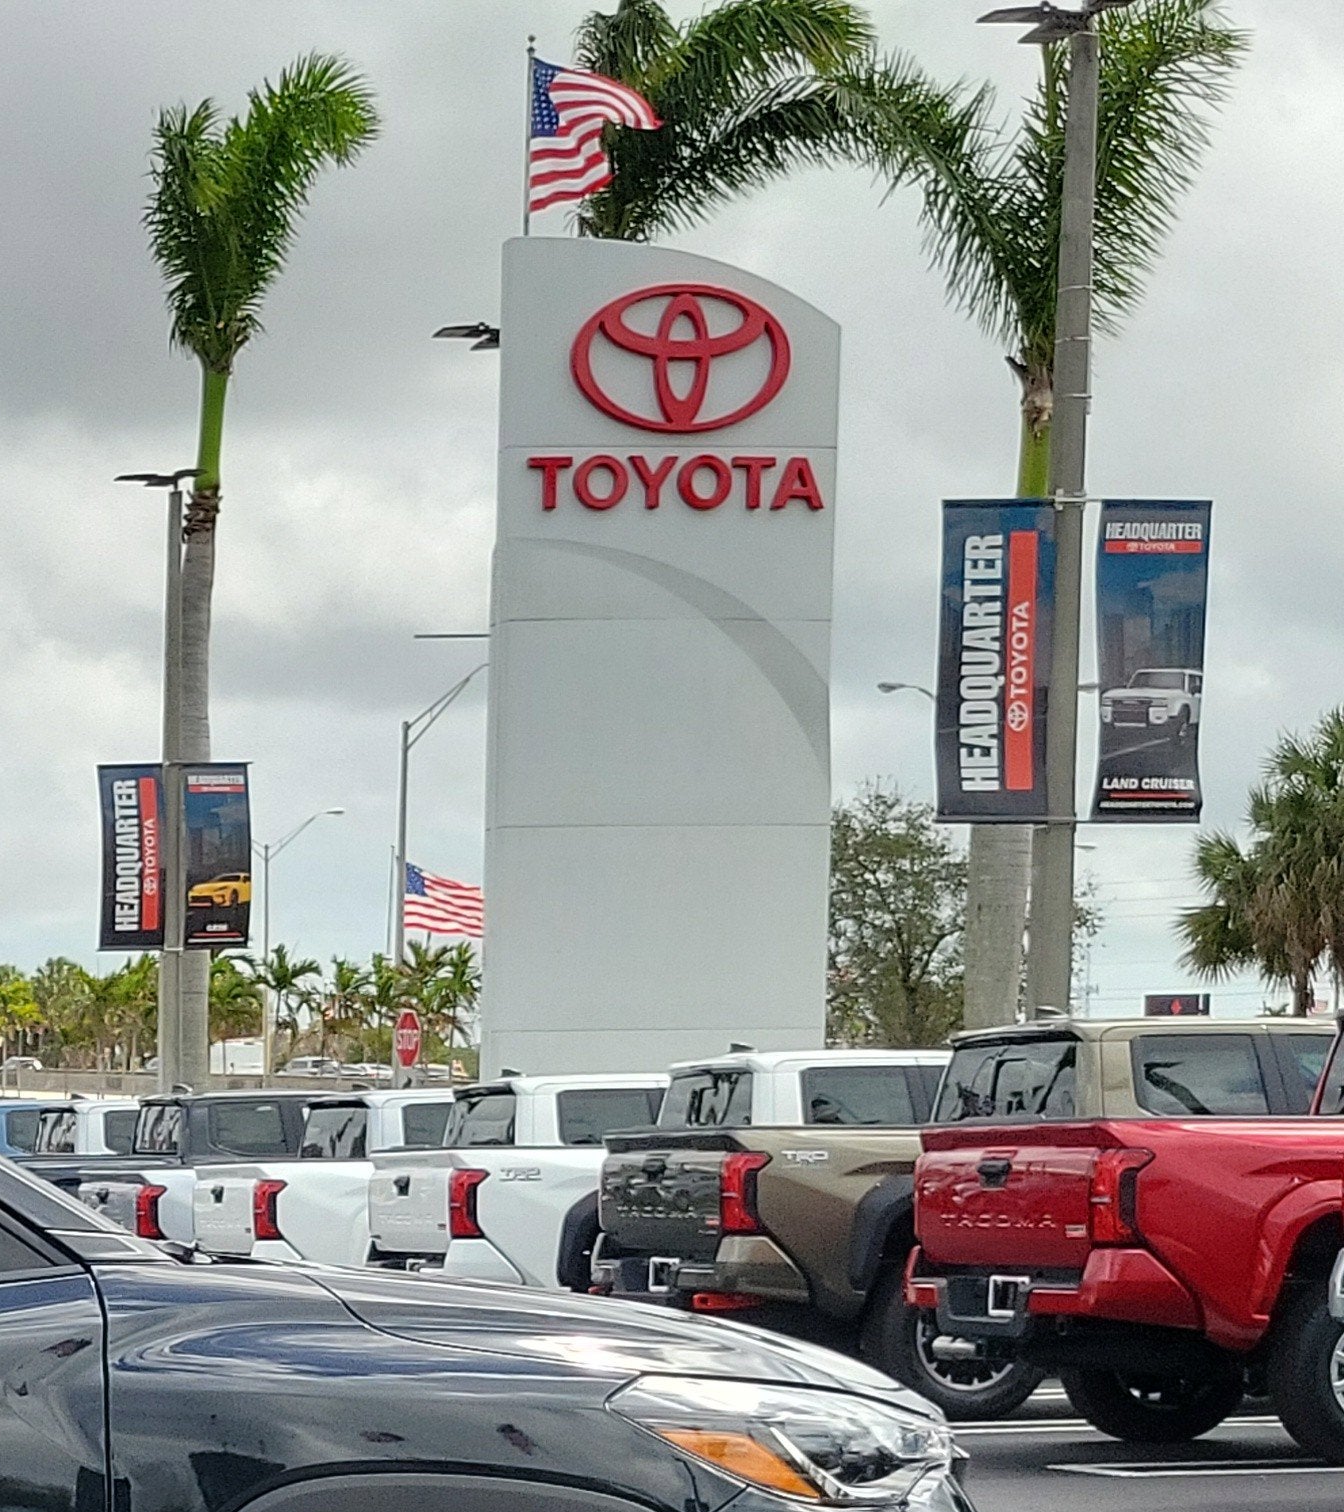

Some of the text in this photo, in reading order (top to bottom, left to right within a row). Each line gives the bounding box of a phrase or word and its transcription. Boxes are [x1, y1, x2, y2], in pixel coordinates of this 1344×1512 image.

[527, 454, 824, 510] TOYOTA
[1105, 523, 1203, 541] HEADQUARTER
[1011, 601, 1030, 695] TOYOTA
[959, 533, 1005, 792] HEADQUARTER
[1102, 778, 1195, 790] LAND CRUISER
[113, 779, 142, 931] HEADQUARTER
[143, 818, 156, 871] TOYOTA
[397, 1029, 420, 1050] STOP
[781, 1150, 829, 1162] TRD
[616, 1205, 698, 1218] TACOMA
[940, 1213, 1056, 1228] TACOMA
